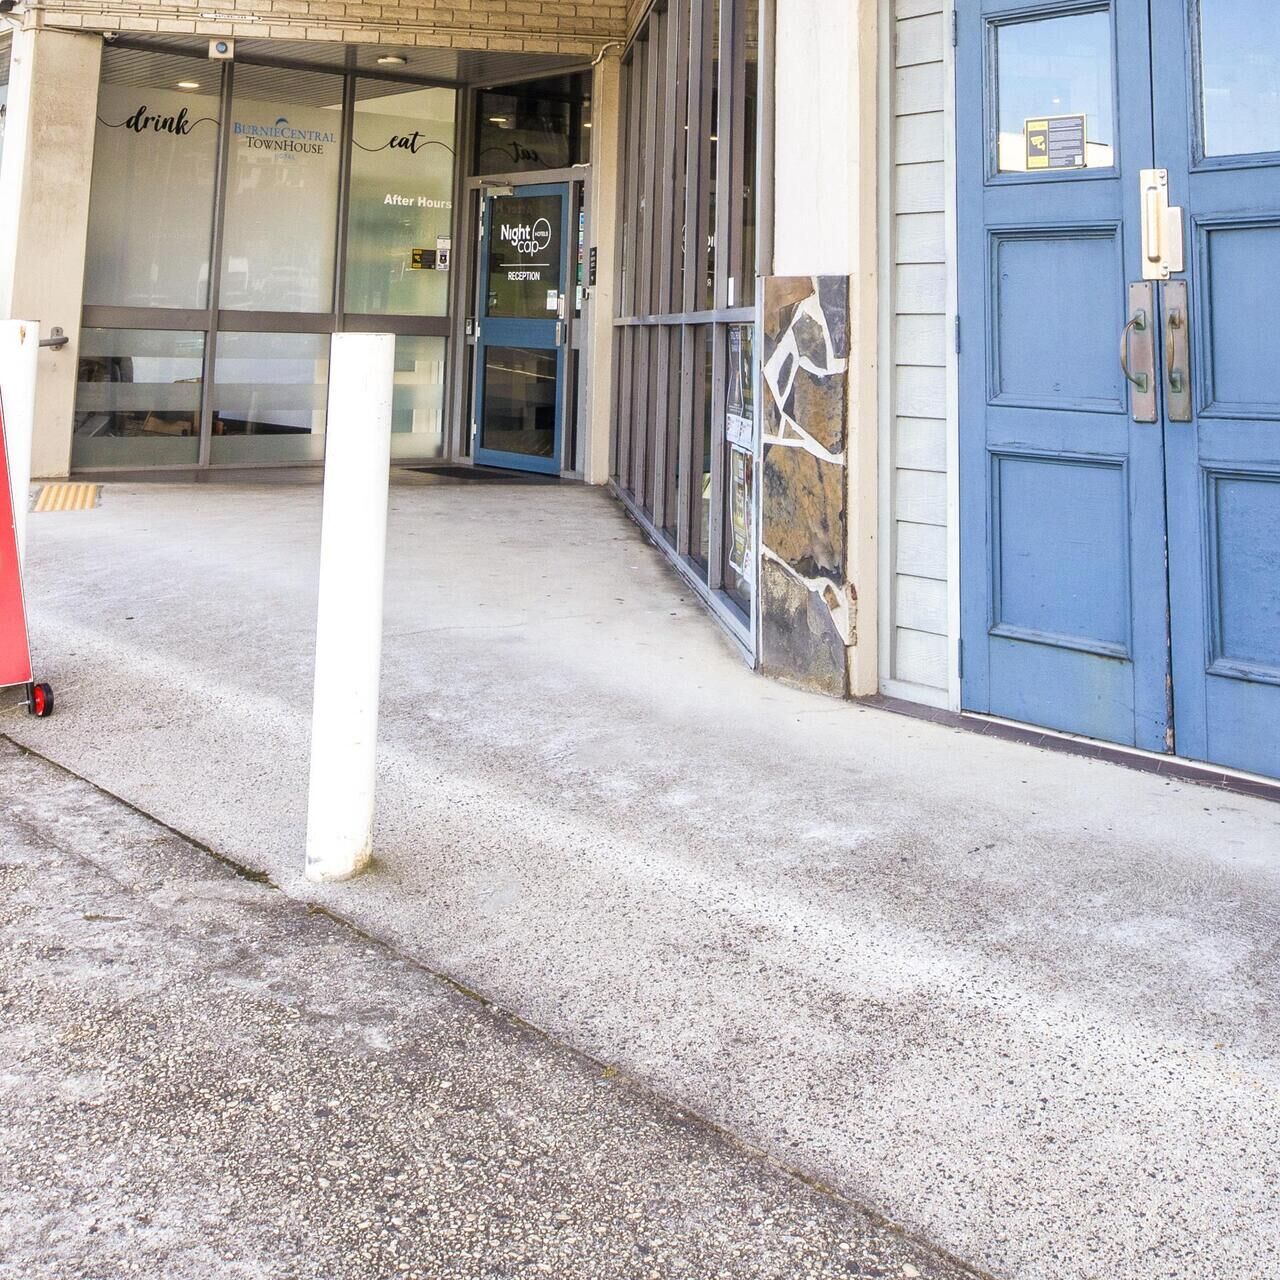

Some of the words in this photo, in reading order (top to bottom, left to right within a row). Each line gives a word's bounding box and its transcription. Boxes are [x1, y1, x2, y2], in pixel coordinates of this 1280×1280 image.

[124, 105, 192, 135] drink
[388, 131, 426, 154] eat
[383, 194, 415, 206] After
[417, 196, 453, 209] Hours
[500, 224, 531, 246] Night
[517, 240, 540, 257] cap
[507, 271, 540, 281] RECEPTION
